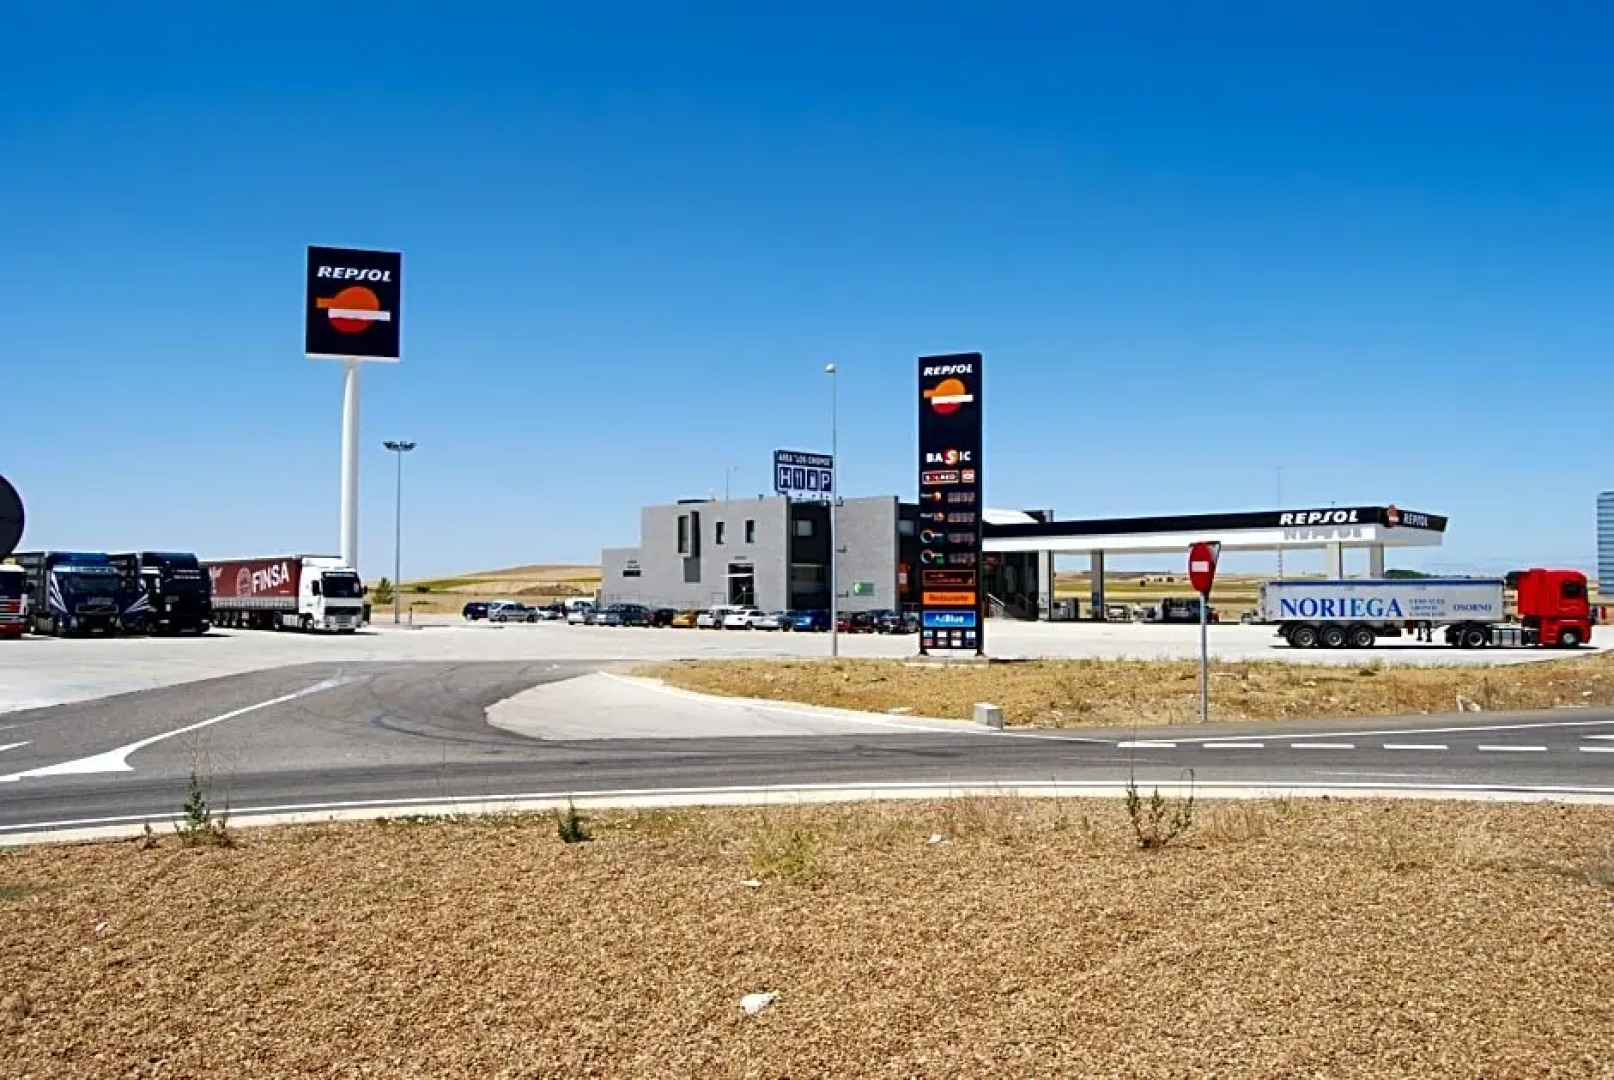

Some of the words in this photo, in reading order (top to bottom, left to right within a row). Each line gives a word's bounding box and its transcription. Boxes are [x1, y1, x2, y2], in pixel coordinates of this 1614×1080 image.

[317, 265, 392, 283] REPSOL
[923, 363, 973, 377] REPSOL
[925, 449, 972, 465] BASIC
[1279, 509, 1359, 526] REPSOL
[1402, 512, 1429, 528] REPSOL
[252, 561, 291, 594] FINSA
[1279, 597, 1404, 618] NORIEGA
[1453, 603, 1493, 612] OSORNO
